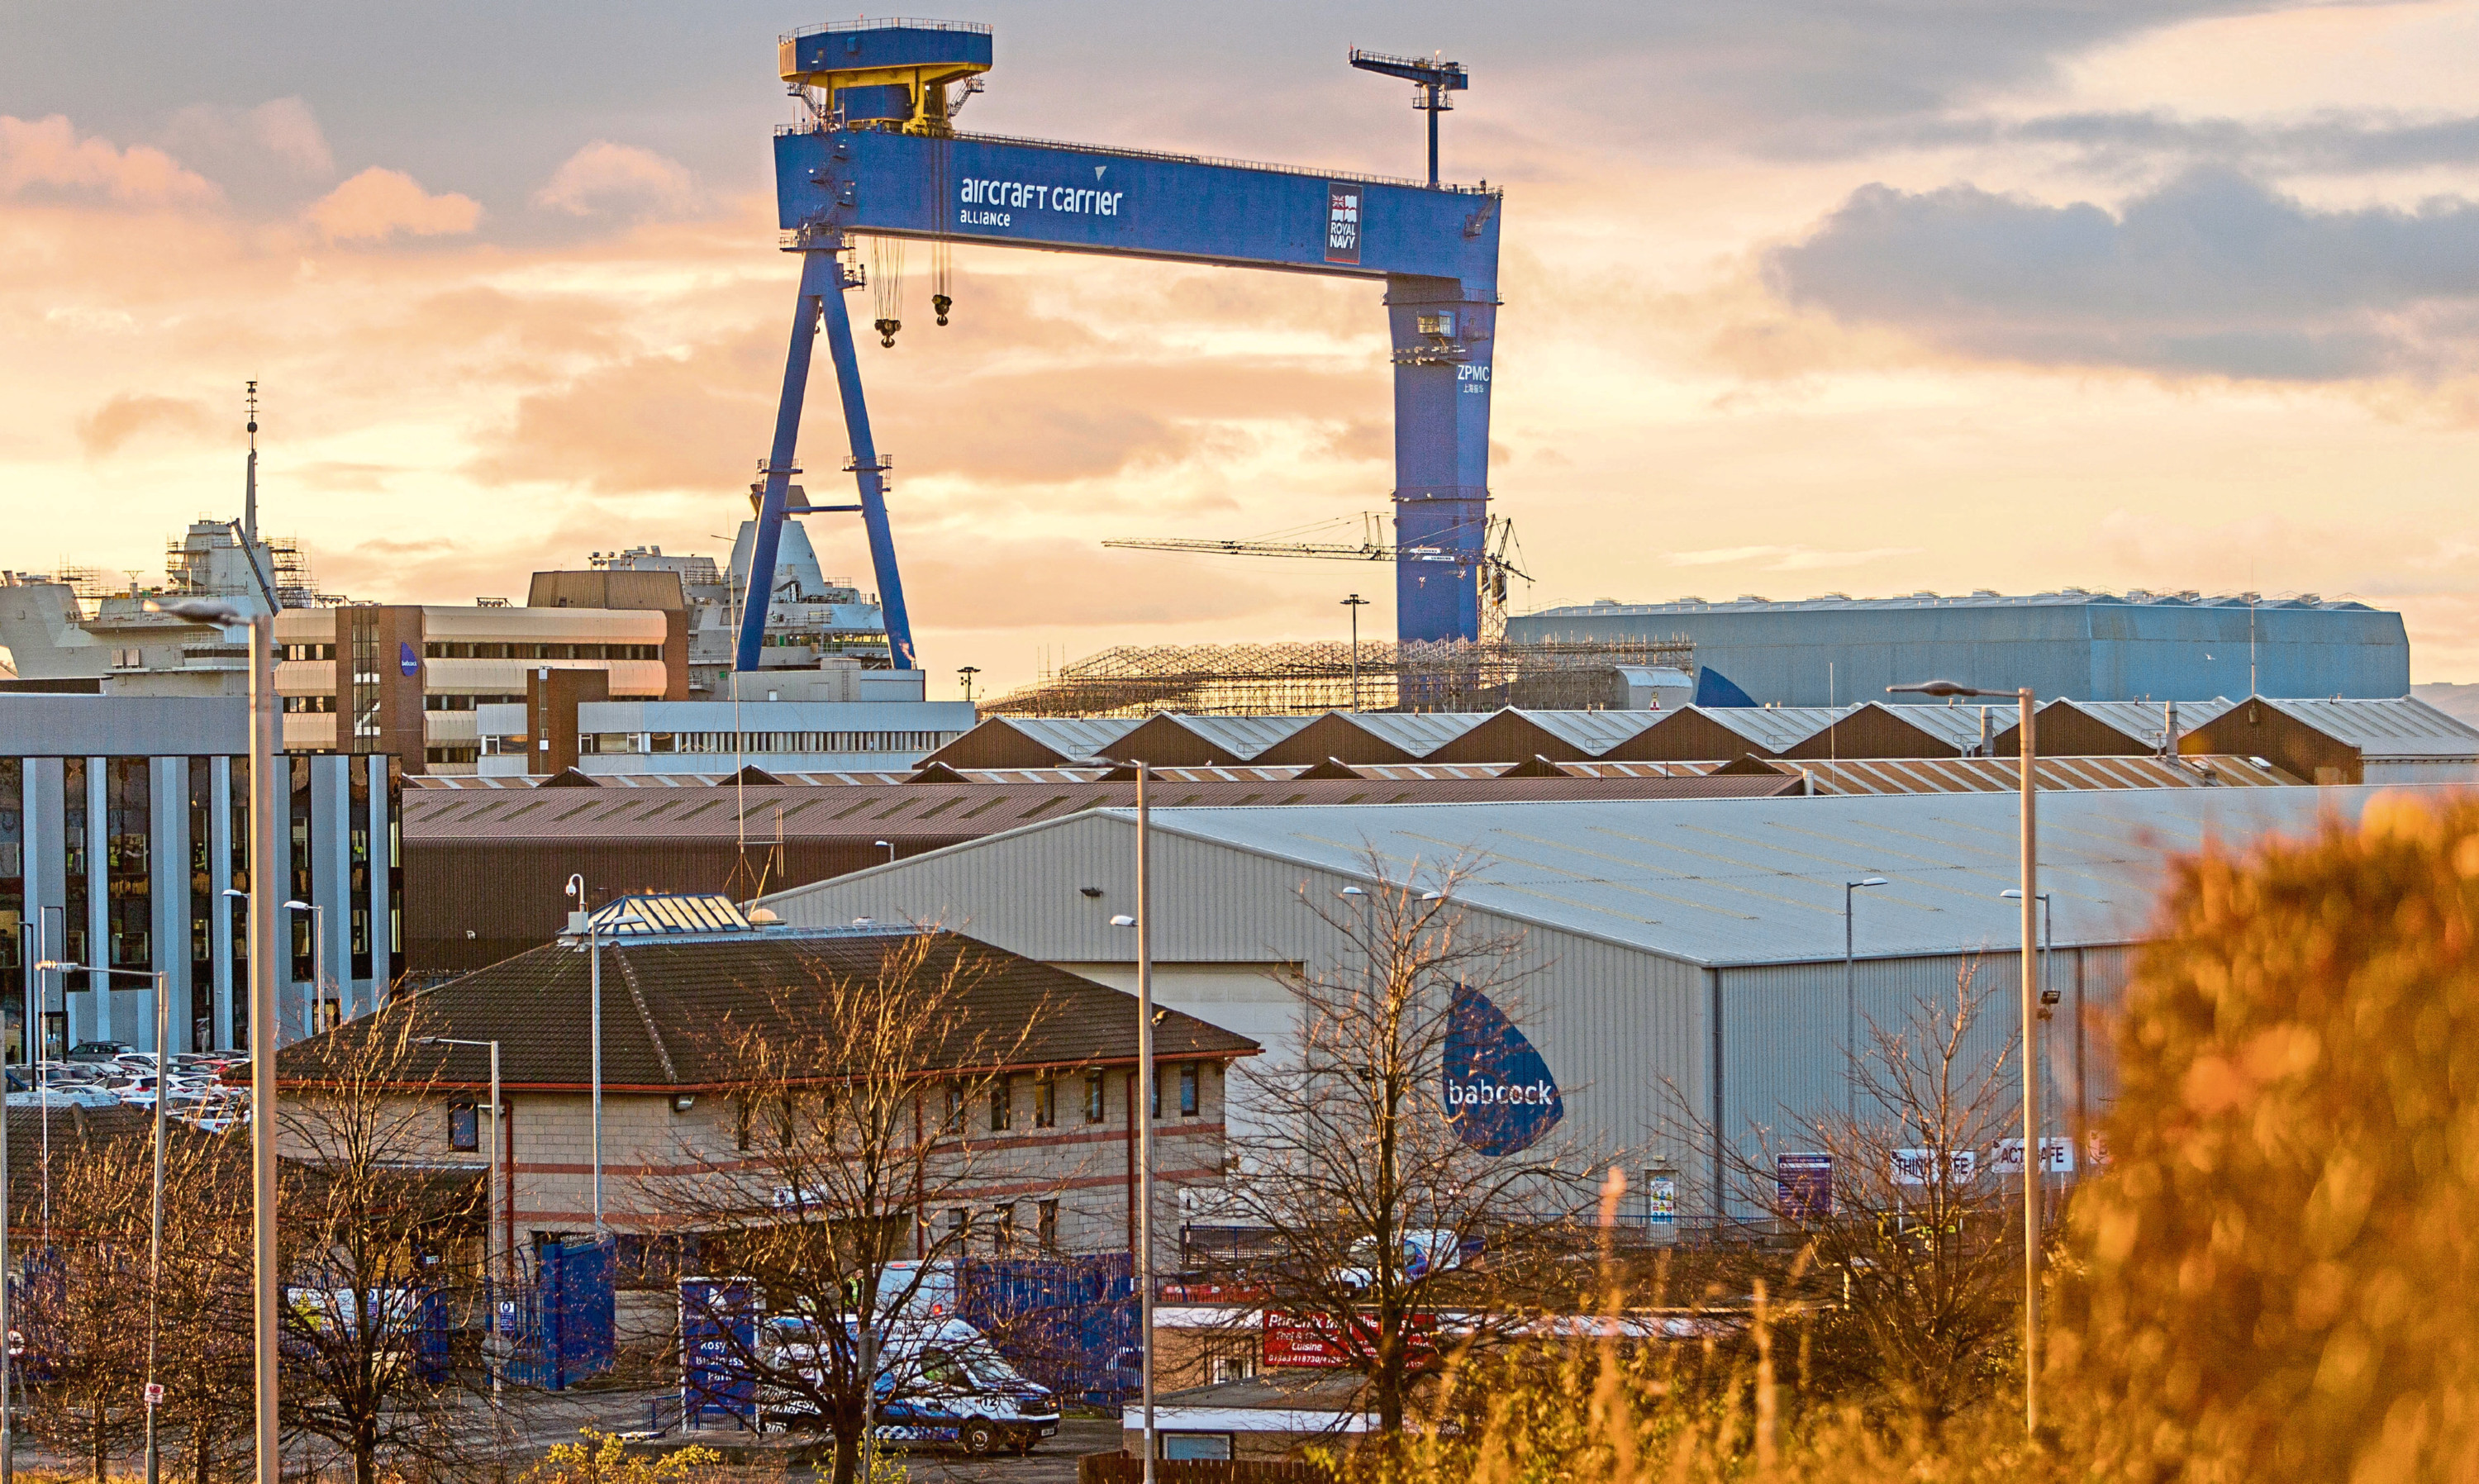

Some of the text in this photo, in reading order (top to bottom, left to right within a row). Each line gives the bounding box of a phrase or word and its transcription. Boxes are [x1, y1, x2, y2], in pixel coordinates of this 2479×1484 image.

[1052, 187, 1124, 216] carrier
[1330, 221, 1356, 236] ROYAL
[1330, 235, 1355, 250] NAVY
[1457, 364, 1491, 383] ZPMC
[1449, 1078, 1553, 1106] babcock
[2035, 1147, 2064, 1163] AFE
[1896, 1158, 1929, 1174] THIN
[1291, 1342, 1323, 1352] Cuisine
[983, 1395, 997, 1407] 12
